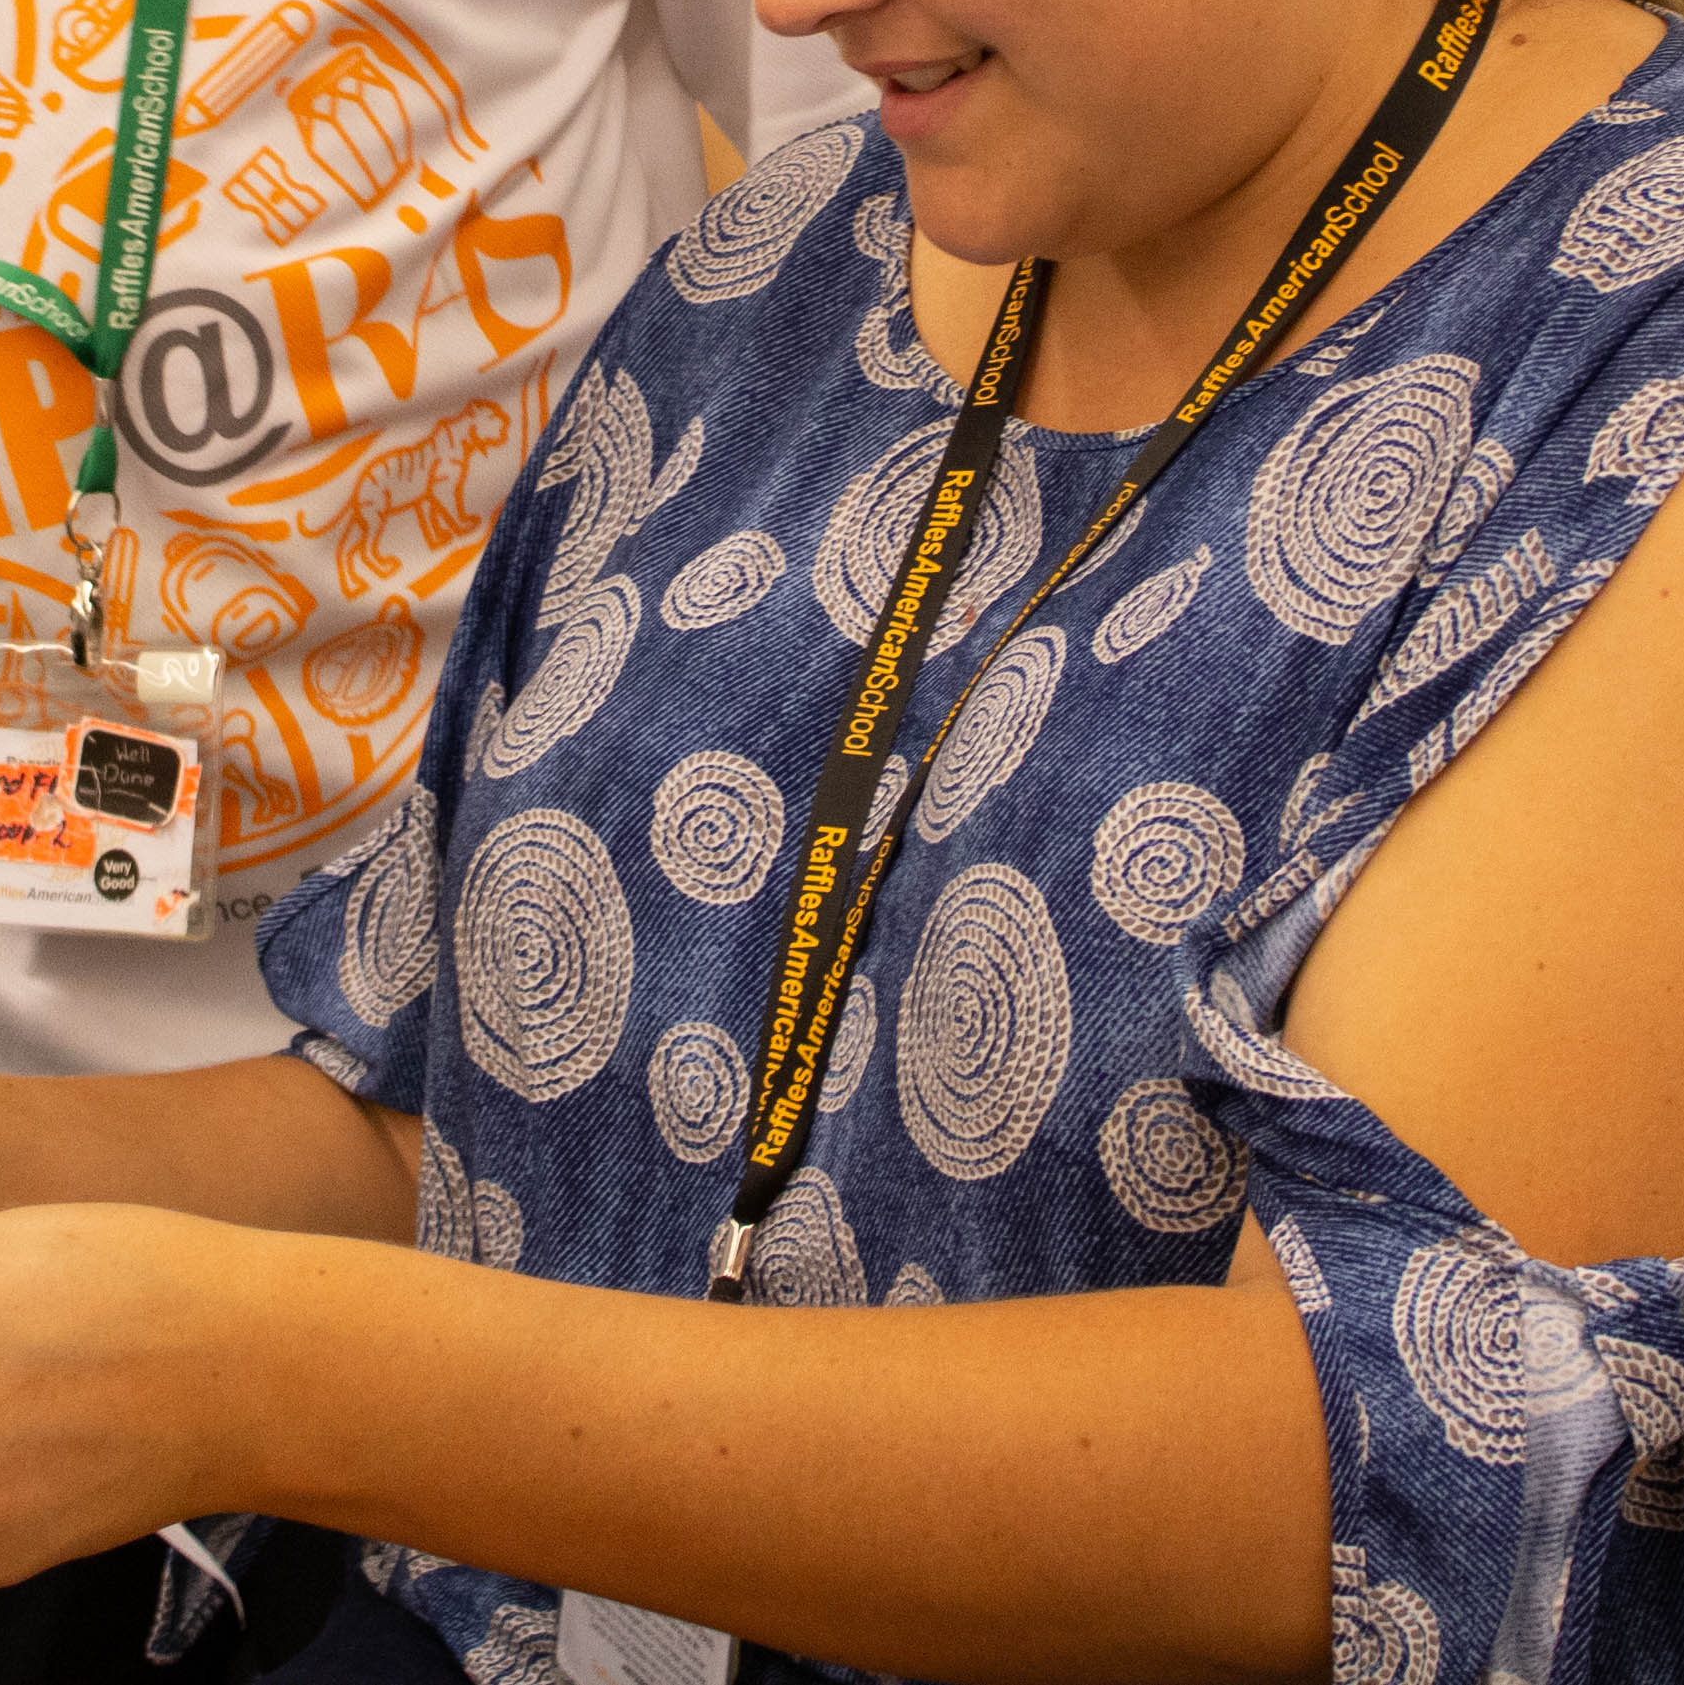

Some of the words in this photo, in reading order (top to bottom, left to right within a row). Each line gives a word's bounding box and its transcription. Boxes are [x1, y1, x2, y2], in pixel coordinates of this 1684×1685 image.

[108, 28, 176, 333] RafflesAmericanSchool
[1176, 140, 1405, 425] RafflesAmericanSchool
[840, 469, 977, 758] RafflesAmericanSchool
[100, 874, 136, 891] Good
[103, 859, 133, 876] Very
[749, 834, 895, 1168] RafflesAmericanSchool
